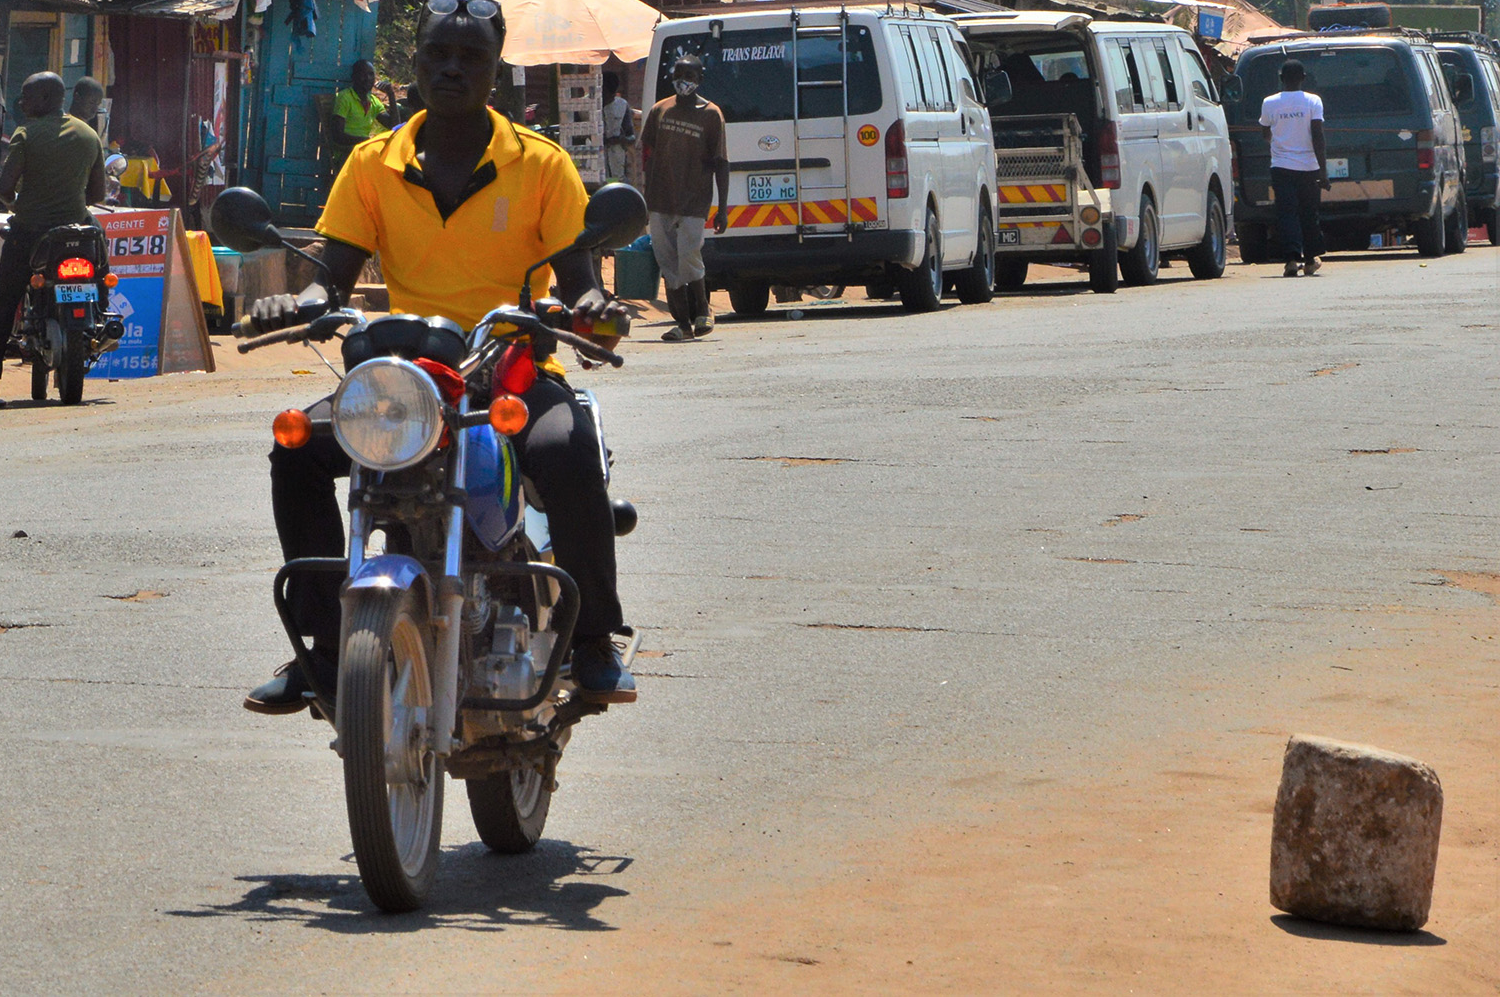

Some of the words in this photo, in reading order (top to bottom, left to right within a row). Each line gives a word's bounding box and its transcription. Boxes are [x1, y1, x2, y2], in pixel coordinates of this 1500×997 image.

[722, 46, 750, 62] TRANS
[751, 44, 786, 61] RELAXA
[860, 130, 877, 141] 100
[750, 176, 772, 188] AJX
[750, 188, 772, 199] 209
[780, 187, 795, 198] MC
[106, 219, 145, 230] AGENTE
[1002, 233, 1016, 243] MC
[61, 293, 73, 302] 05
[85, 292, 96, 301] 21
